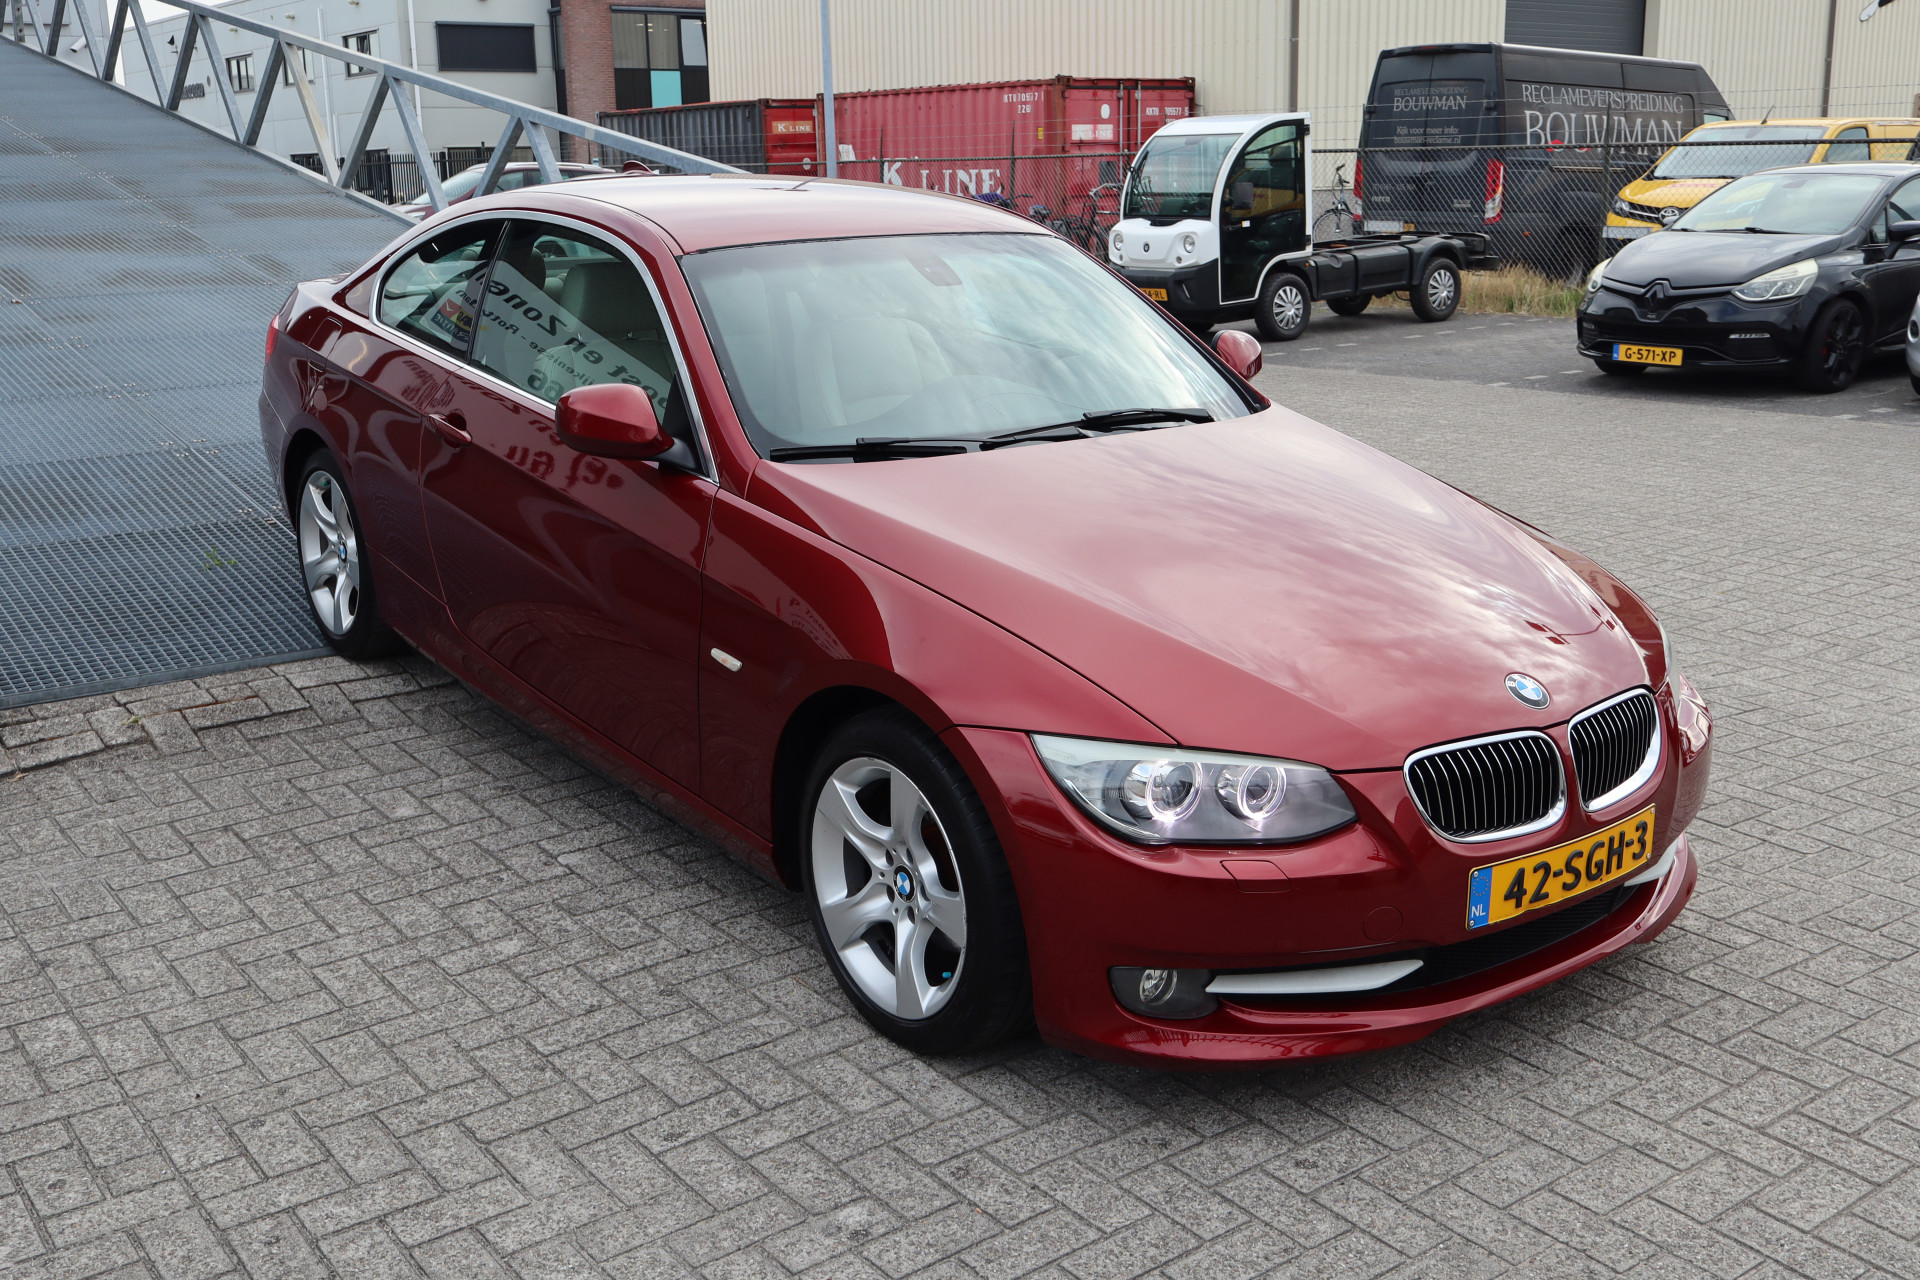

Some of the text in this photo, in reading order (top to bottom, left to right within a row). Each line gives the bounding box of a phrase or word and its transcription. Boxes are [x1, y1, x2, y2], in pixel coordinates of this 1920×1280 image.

[1393, 95, 1467, 112] BOUWMAN
[1522, 84, 1684, 114] RECLAMEVERSPREIDING
[1393, 135, 1461, 144] bouwman-reclame.nl
[1396, 126, 1409, 136] Kijk
[1444, 126, 1460, 135] info:
[1524, 110, 1683, 156] BOUWMAN
[920, 169, 1001, 197] LINE
[1624, 347, 1677, 363] G-571-XP
[1503, 819, 1648, 909] 42-SGH-3
[1471, 903, 1487, 918] NL
